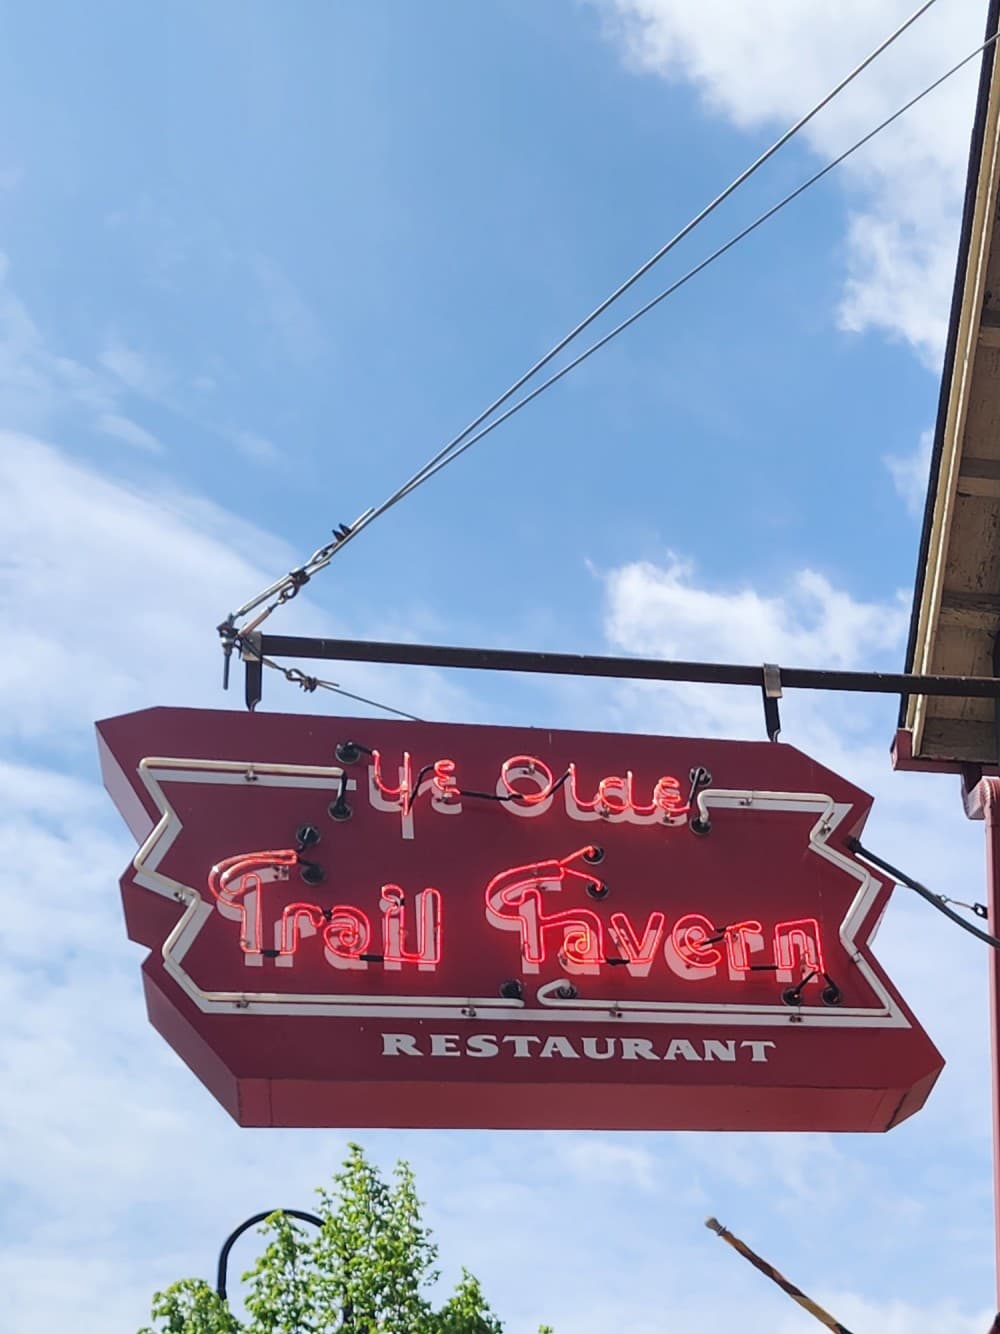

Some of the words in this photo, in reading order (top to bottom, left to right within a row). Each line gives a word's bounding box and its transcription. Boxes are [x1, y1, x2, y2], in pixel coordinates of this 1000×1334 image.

[496, 756, 693, 827] Olde
[208, 849, 443, 972] Trail
[485, 858, 828, 984] Tavern
[381, 1033, 777, 1063] RESTAURANT
